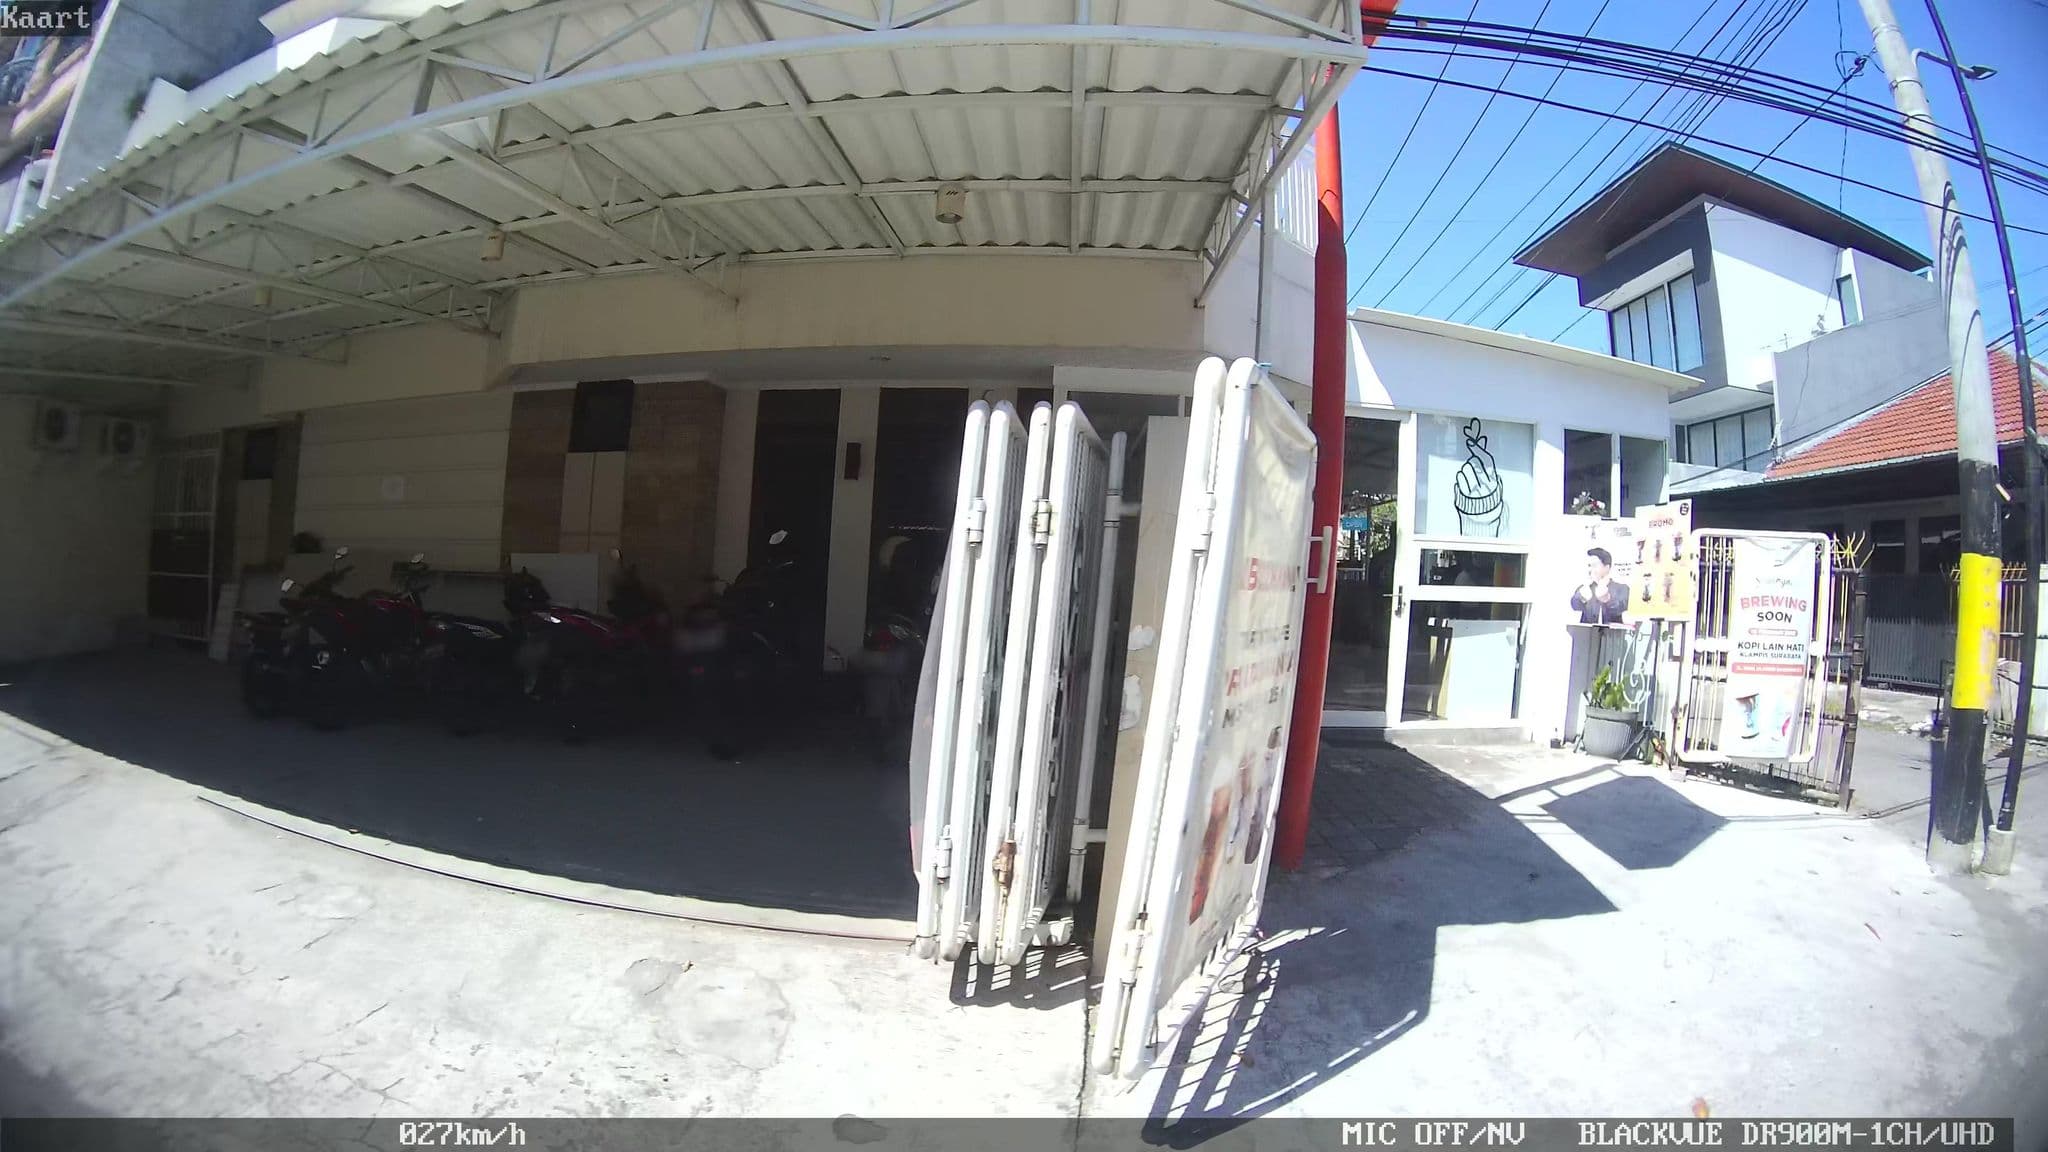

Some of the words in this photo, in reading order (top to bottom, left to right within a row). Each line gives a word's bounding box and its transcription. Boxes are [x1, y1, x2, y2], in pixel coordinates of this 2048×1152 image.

[1740, 595, 1807, 612] BREWING
[1757, 611, 1793, 623] SOON
[1738, 641, 1760, 650] KOPI
[1763, 642, 1784, 651] LAIN
[1786, 643, 1805, 652] HATI
